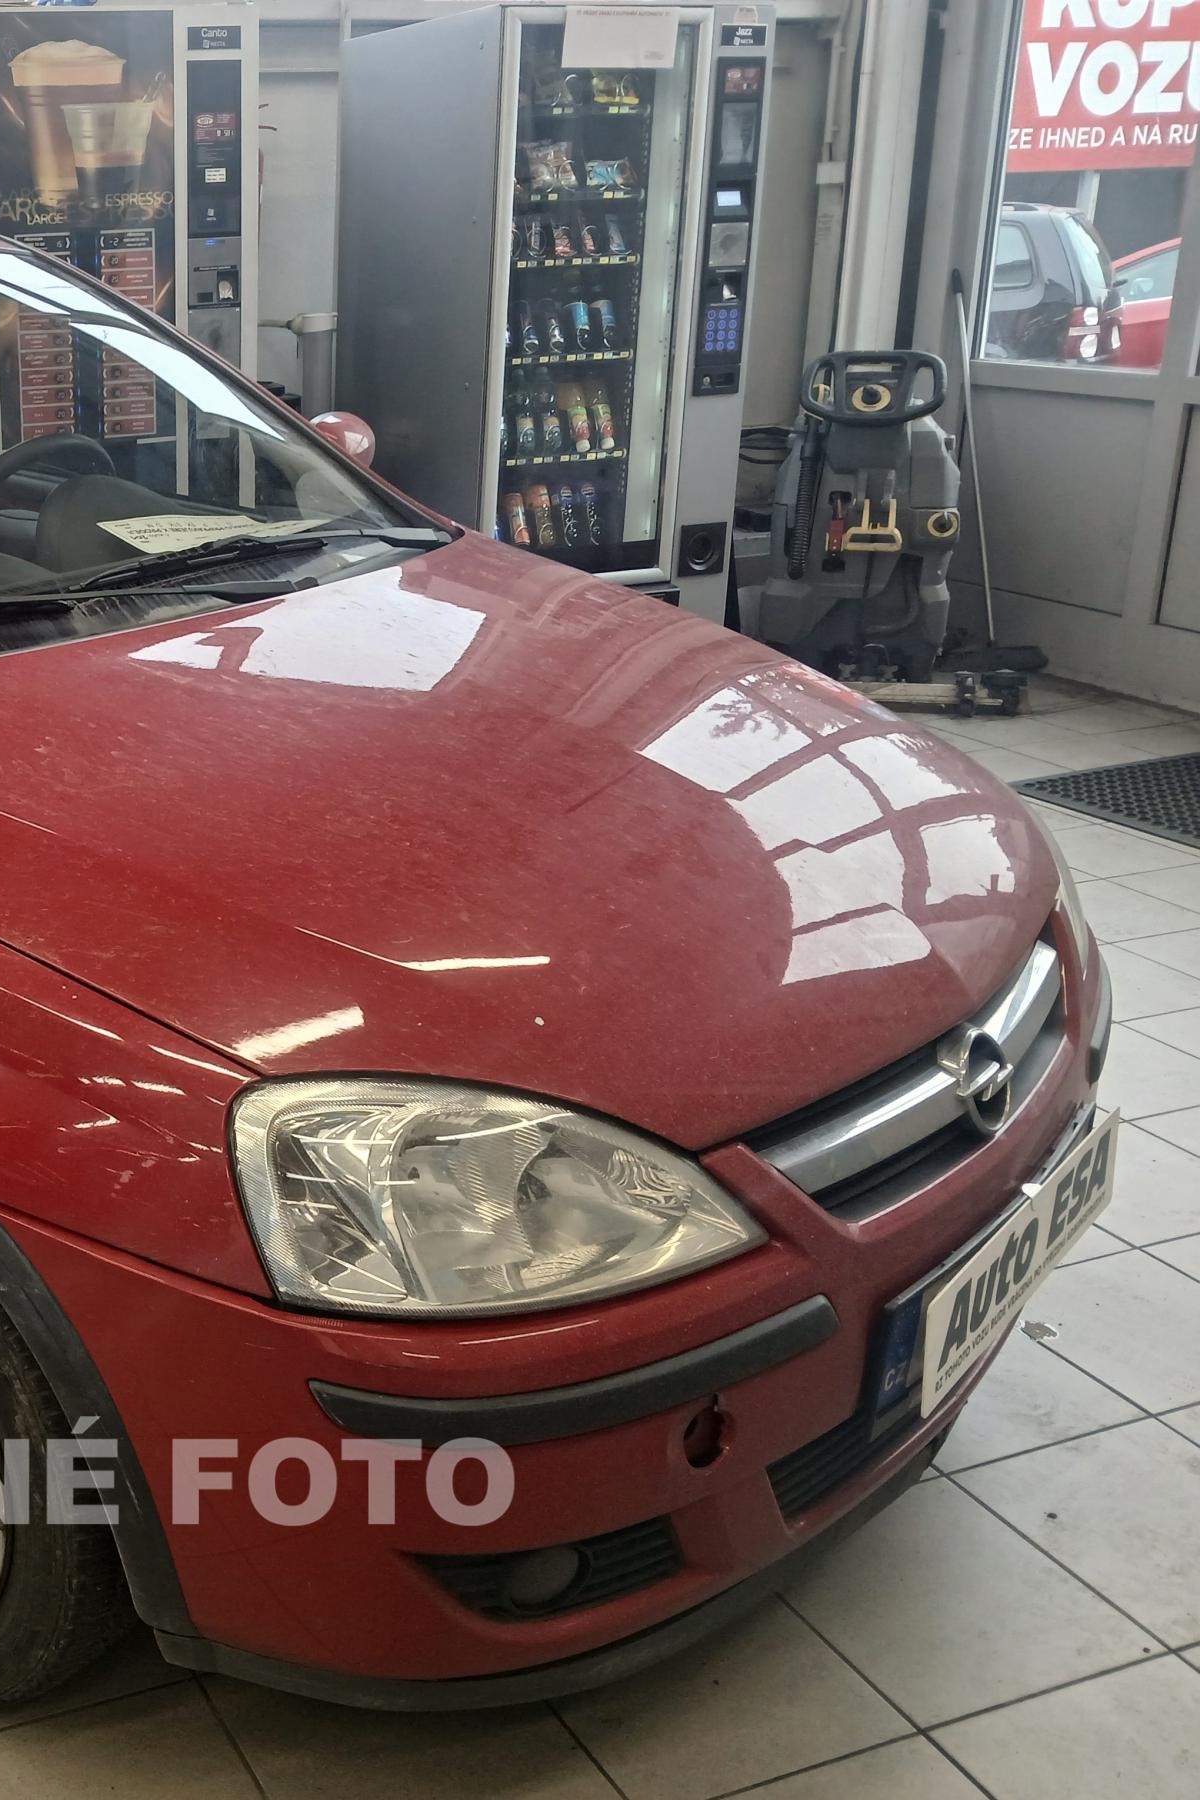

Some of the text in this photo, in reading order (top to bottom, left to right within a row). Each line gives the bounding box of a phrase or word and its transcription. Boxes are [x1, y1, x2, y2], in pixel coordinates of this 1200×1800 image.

[1027, 40, 1200, 116] VOZ
[1039, 127, 1105, 148] IHNED
[1110, 126, 1127, 146] A
[1132, 125, 1162, 145] NA
[105, 191, 173, 207] ESPRESSO
[27, 213, 65, 225] LARGE
[1047, 1129, 1111, 1250] ESA
